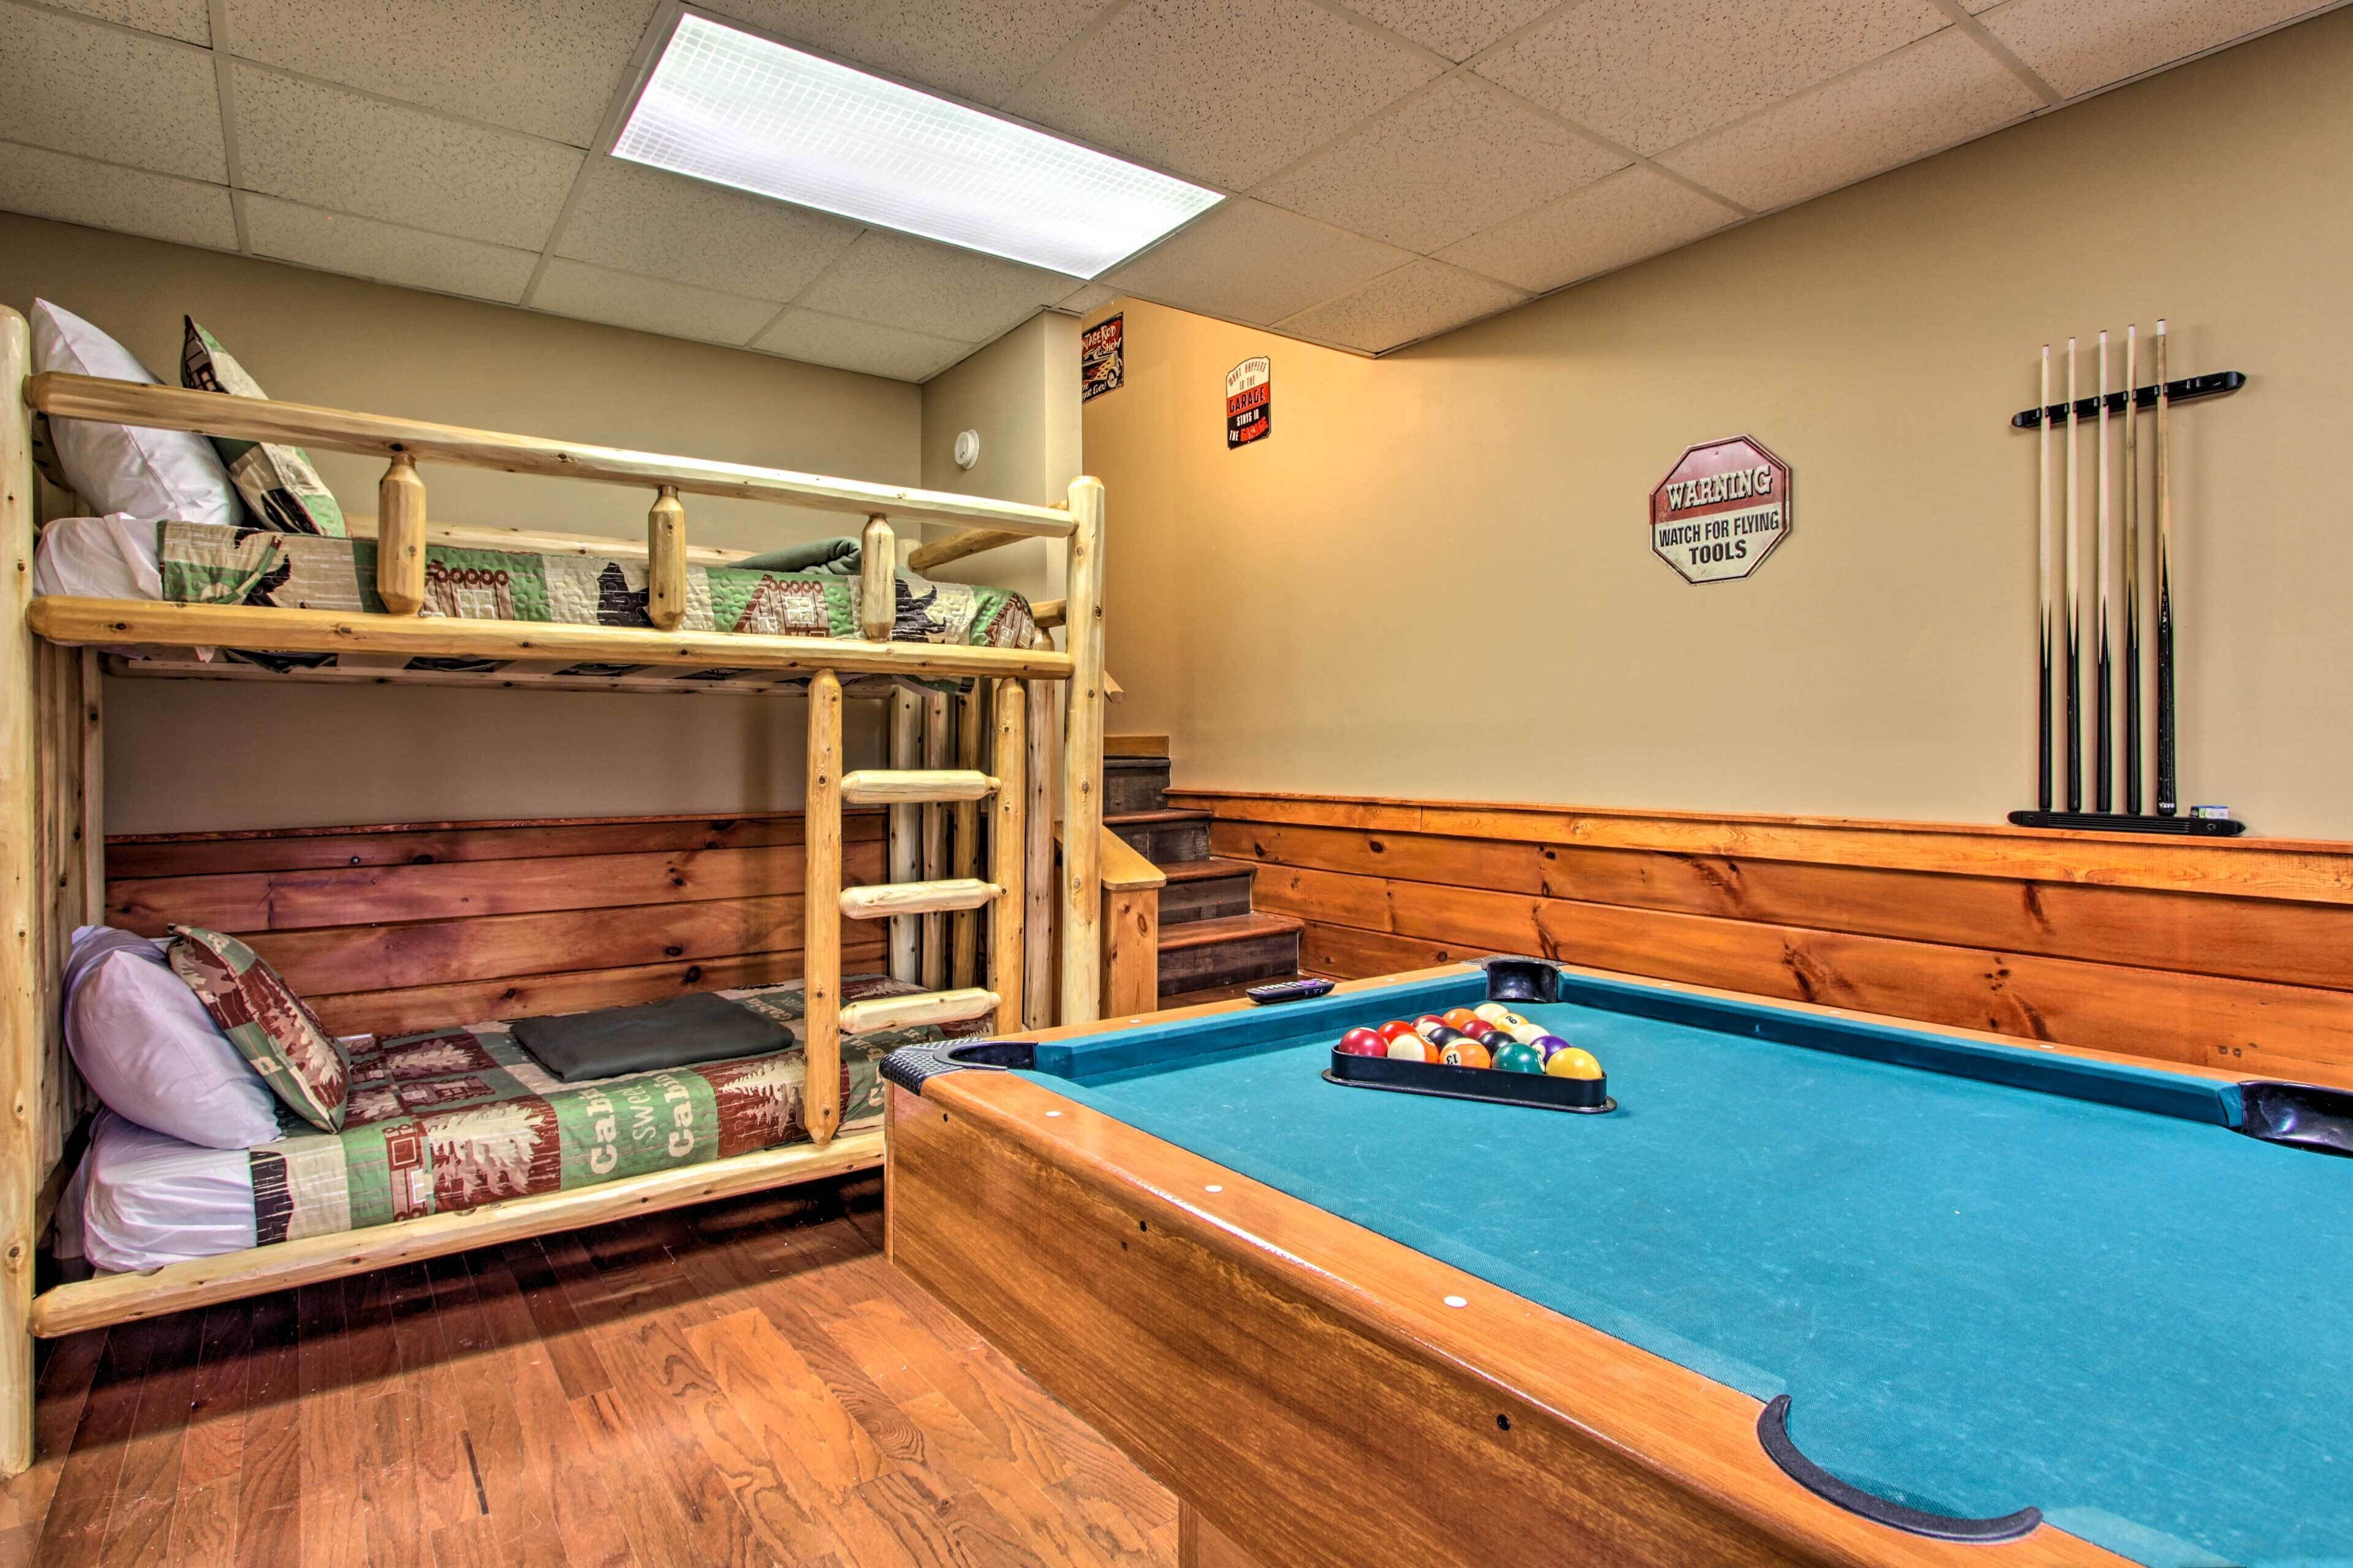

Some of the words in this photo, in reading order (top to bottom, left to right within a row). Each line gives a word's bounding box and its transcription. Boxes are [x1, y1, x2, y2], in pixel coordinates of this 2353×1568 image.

[1228, 368, 1241, 387] WHAT
[1245, 361, 1267, 374] HAPPENS
[1240, 380, 1245, 390] IN
[1229, 387, 1264, 413] GARAGE
[1229, 430, 1239, 441] THE
[1240, 417, 1268, 442] GARAGE
[1237, 411, 1252, 426] STAYS
[1254, 409, 1259, 420] IN
[1666, 464, 1772, 511] WARNING
[1659, 524, 1700, 547] WATCH
[1705, 519, 1729, 540] FOR
[1734, 510, 1779, 536] FLYING
[1689, 539, 1747, 565] TOOLS
[1446, 1053, 1458, 1064] 13
[654, 1074, 695, 1157] Cabin
[578, 1088, 618, 1174] Cabin
